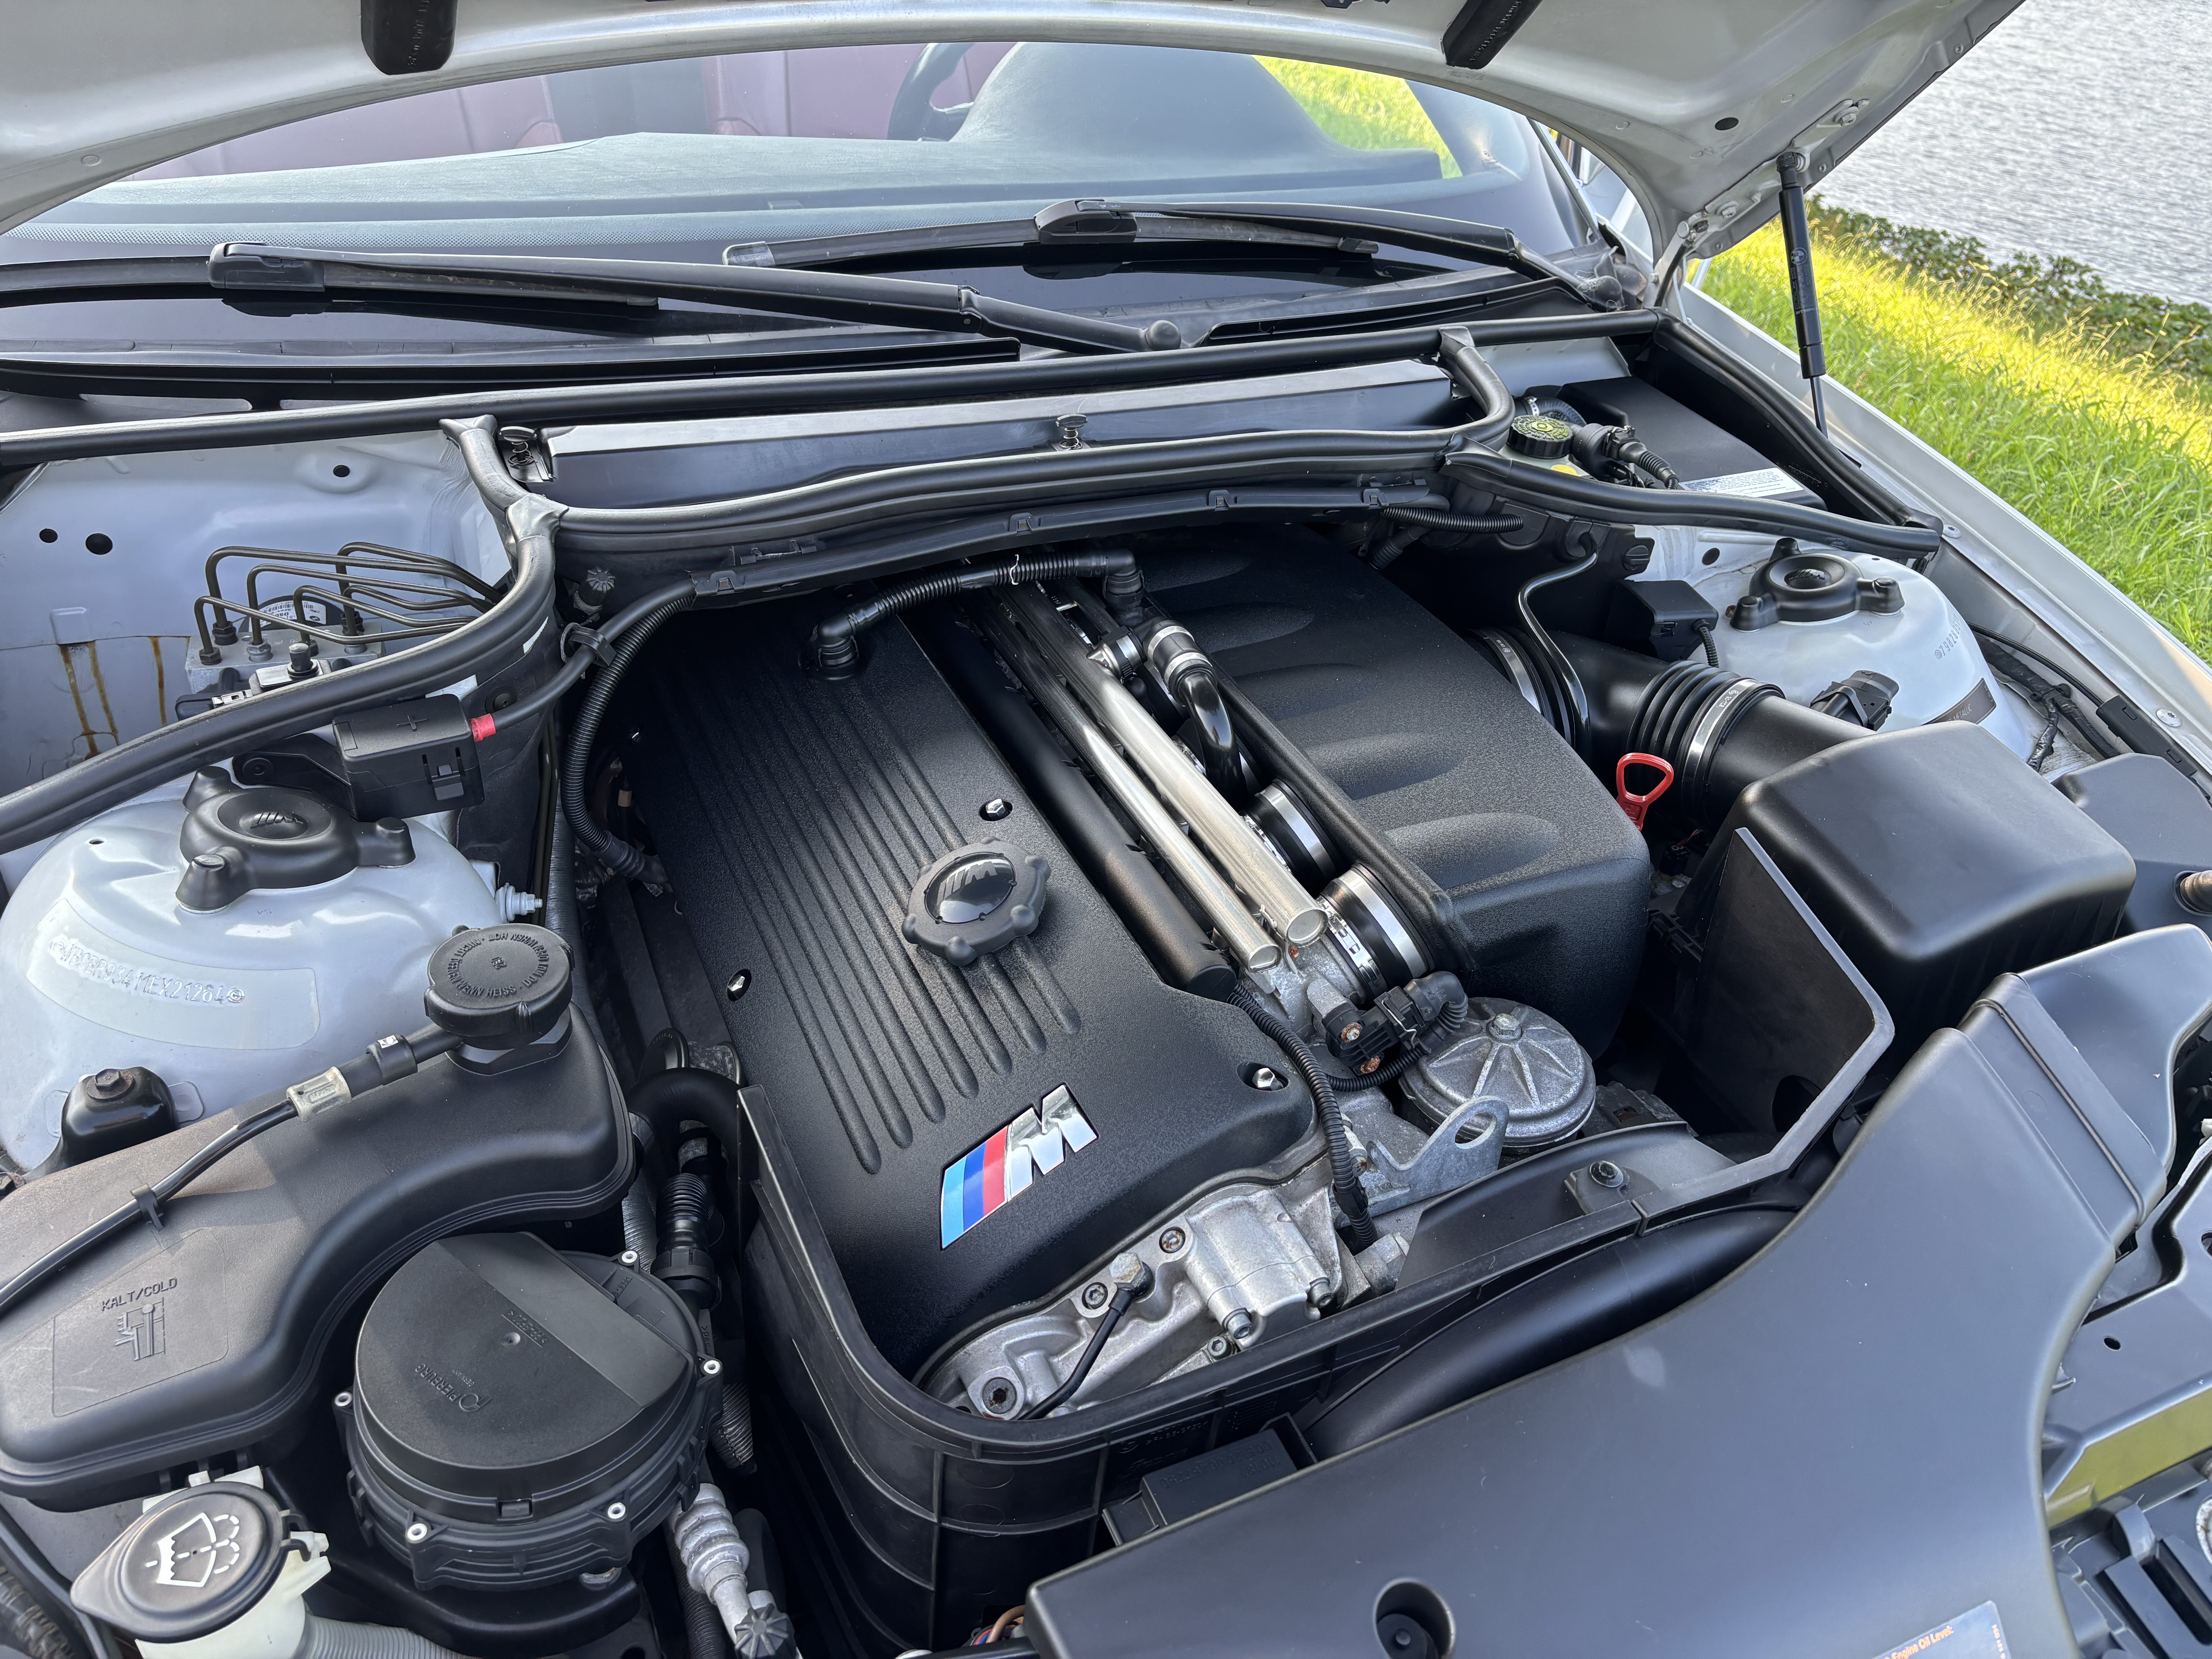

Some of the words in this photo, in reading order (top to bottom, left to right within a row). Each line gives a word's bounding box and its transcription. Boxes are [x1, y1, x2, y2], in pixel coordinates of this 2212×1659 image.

[488, 932, 508, 942] HOT
[532, 944, 549, 962] OPEN
[485, 986, 517, 998] HEISS
[102, 1277, 177, 1311] KALT/COLD
[415, 1363, 460, 1402] PIERBURG
[1918, 1636, 1931, 1649] Oil
